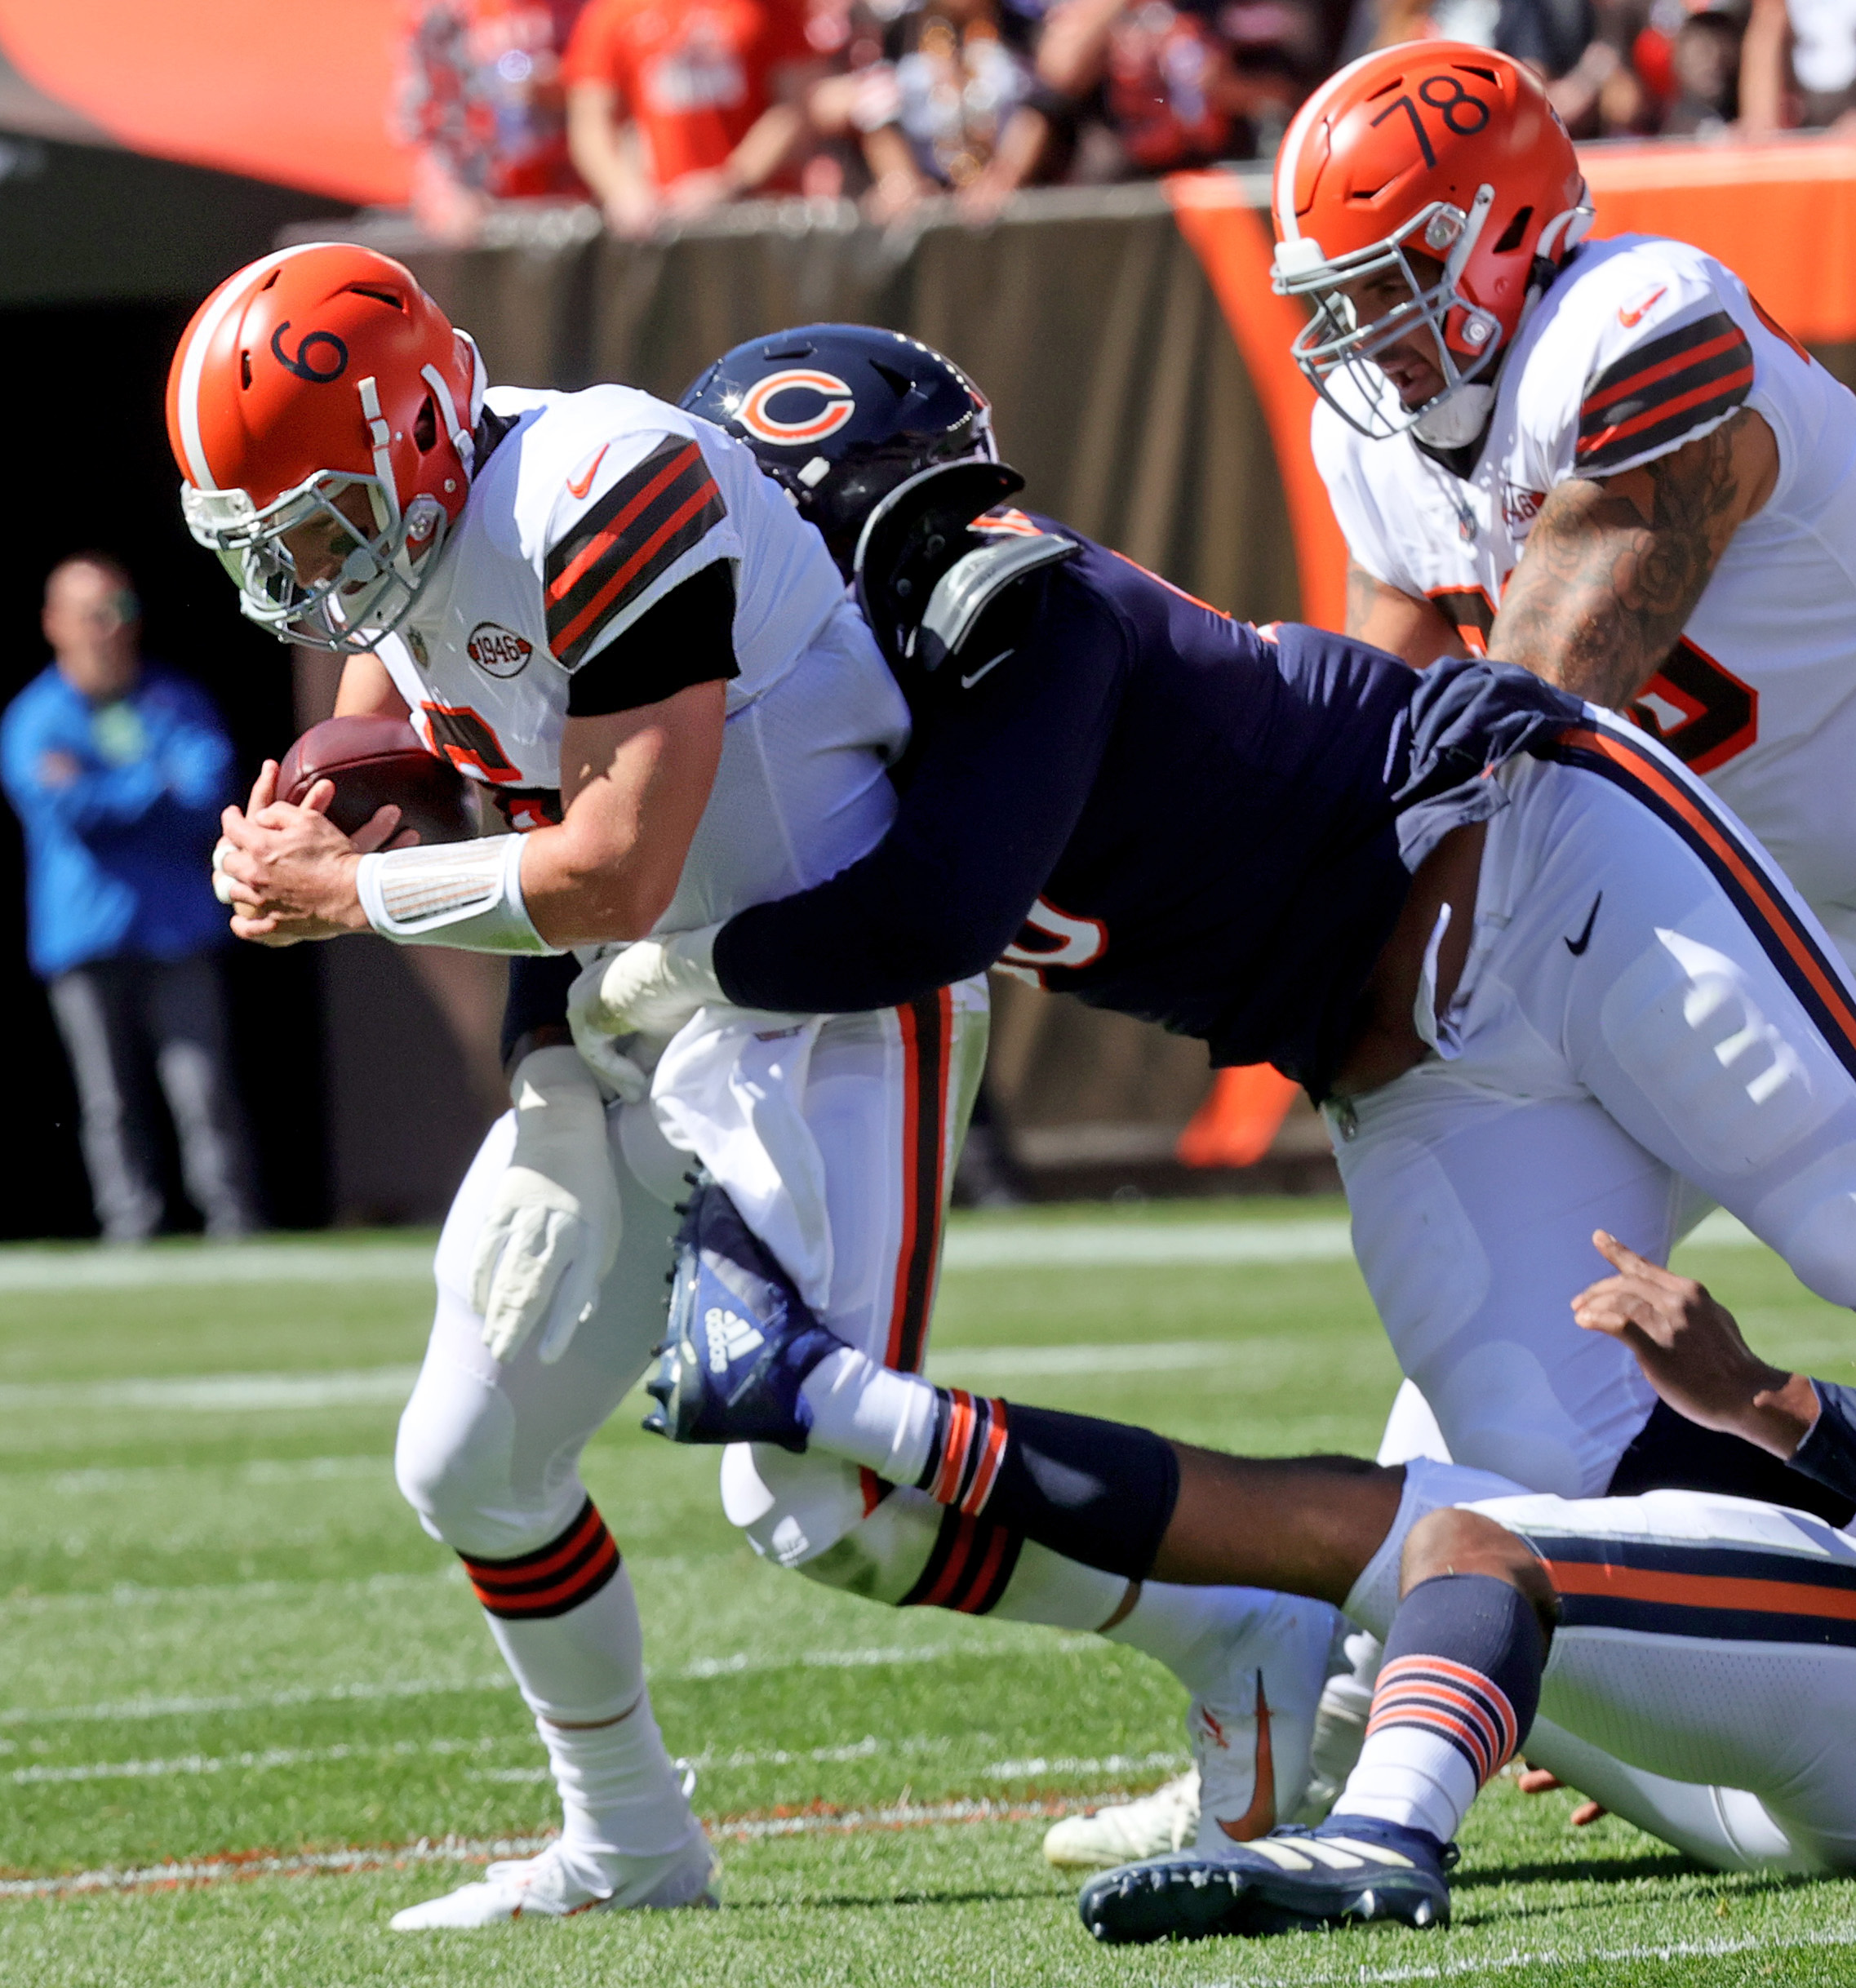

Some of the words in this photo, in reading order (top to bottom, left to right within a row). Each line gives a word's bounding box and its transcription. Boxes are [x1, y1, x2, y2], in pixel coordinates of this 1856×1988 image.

[1370, 75, 1490, 170] 78
[271, 321, 349, 384] 6
[731, 368, 856, 446] C
[476, 635, 520, 664] 1946
[704, 1307, 728, 1373] adidas
